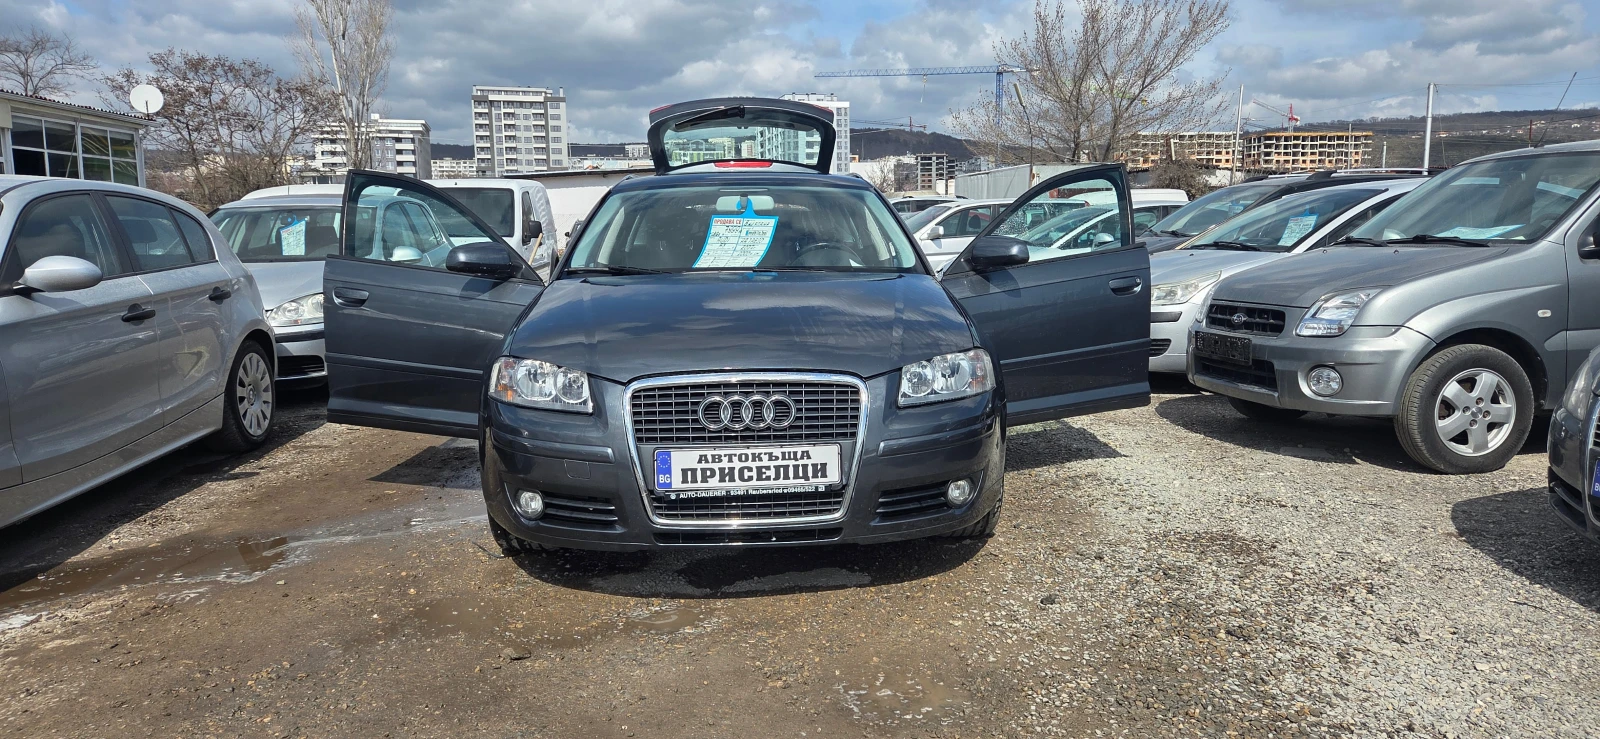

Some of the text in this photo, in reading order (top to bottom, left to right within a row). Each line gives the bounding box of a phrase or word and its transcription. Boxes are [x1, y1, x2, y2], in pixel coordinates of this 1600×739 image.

[697, 450, 812, 464] АВТОКЪЩА
[660, 474, 670, 484] BG
[681, 462, 828, 484] ПРИСЕЛЦИ
